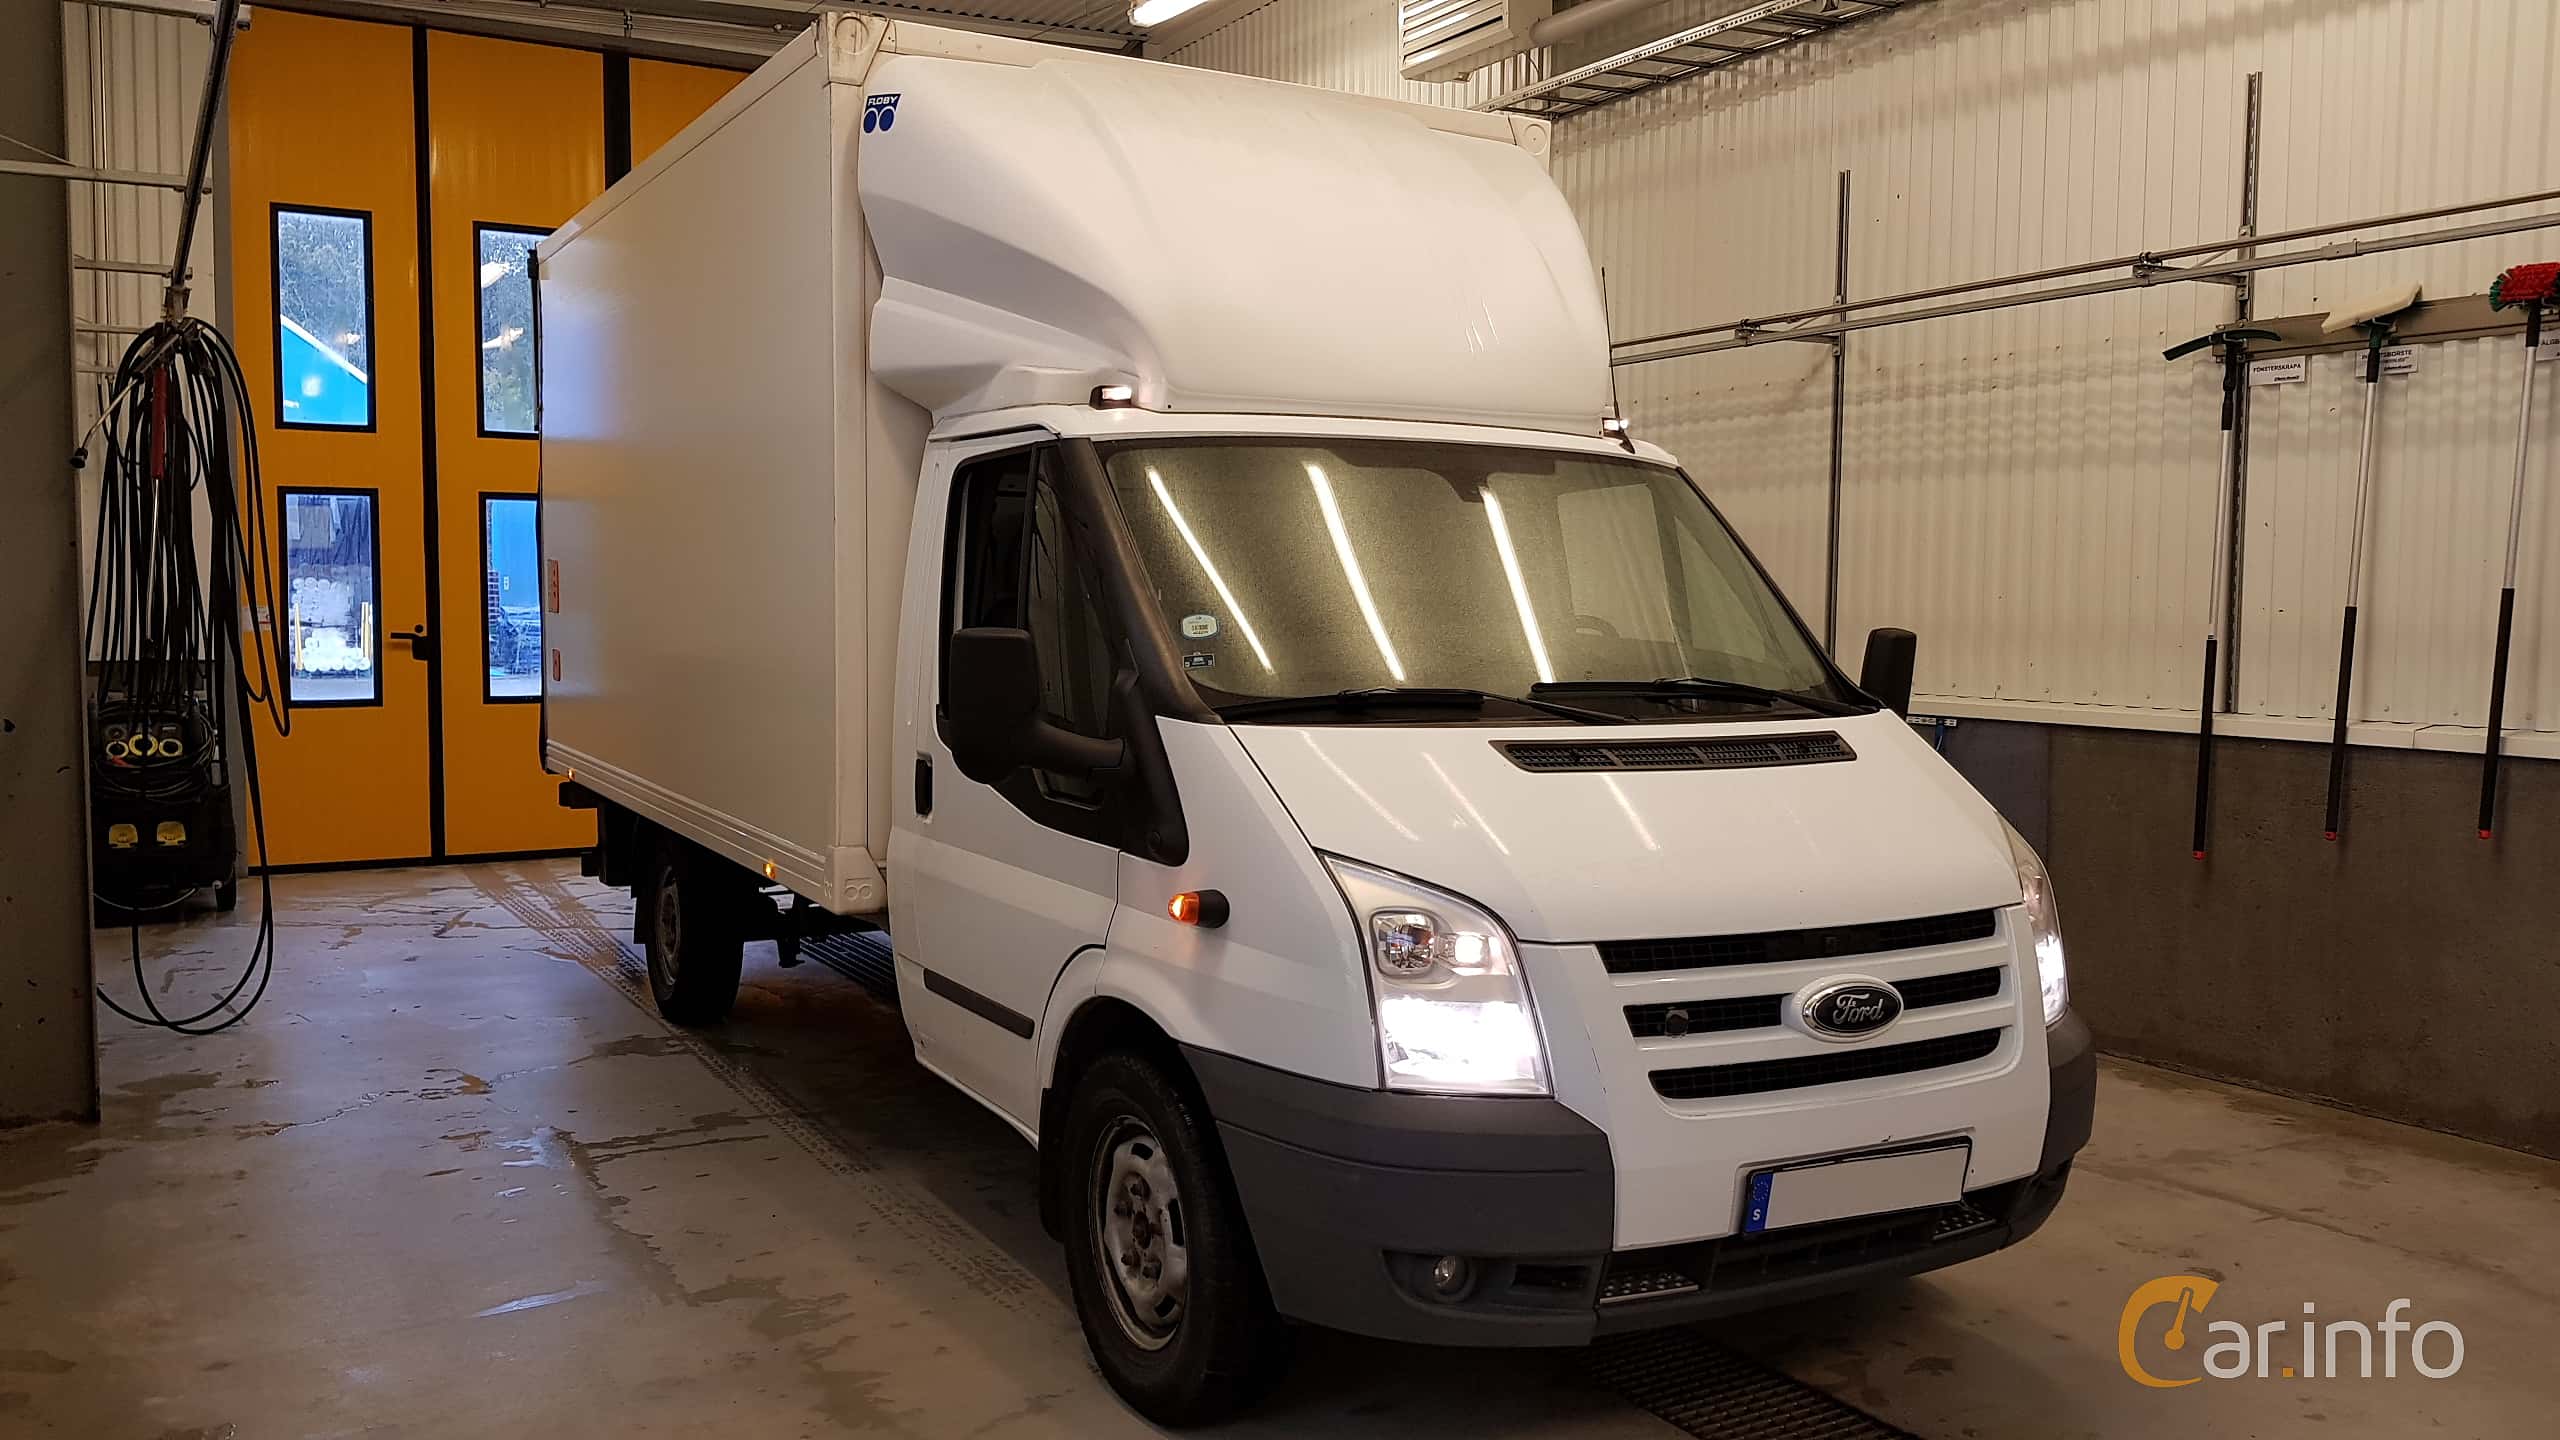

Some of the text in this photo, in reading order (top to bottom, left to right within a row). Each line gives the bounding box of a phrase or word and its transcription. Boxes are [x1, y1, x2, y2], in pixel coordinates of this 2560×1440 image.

[868, 96, 898, 106] FLOBY
[1833, 993, 1884, 1025] Ford
[1752, 1208, 1761, 1221] S
